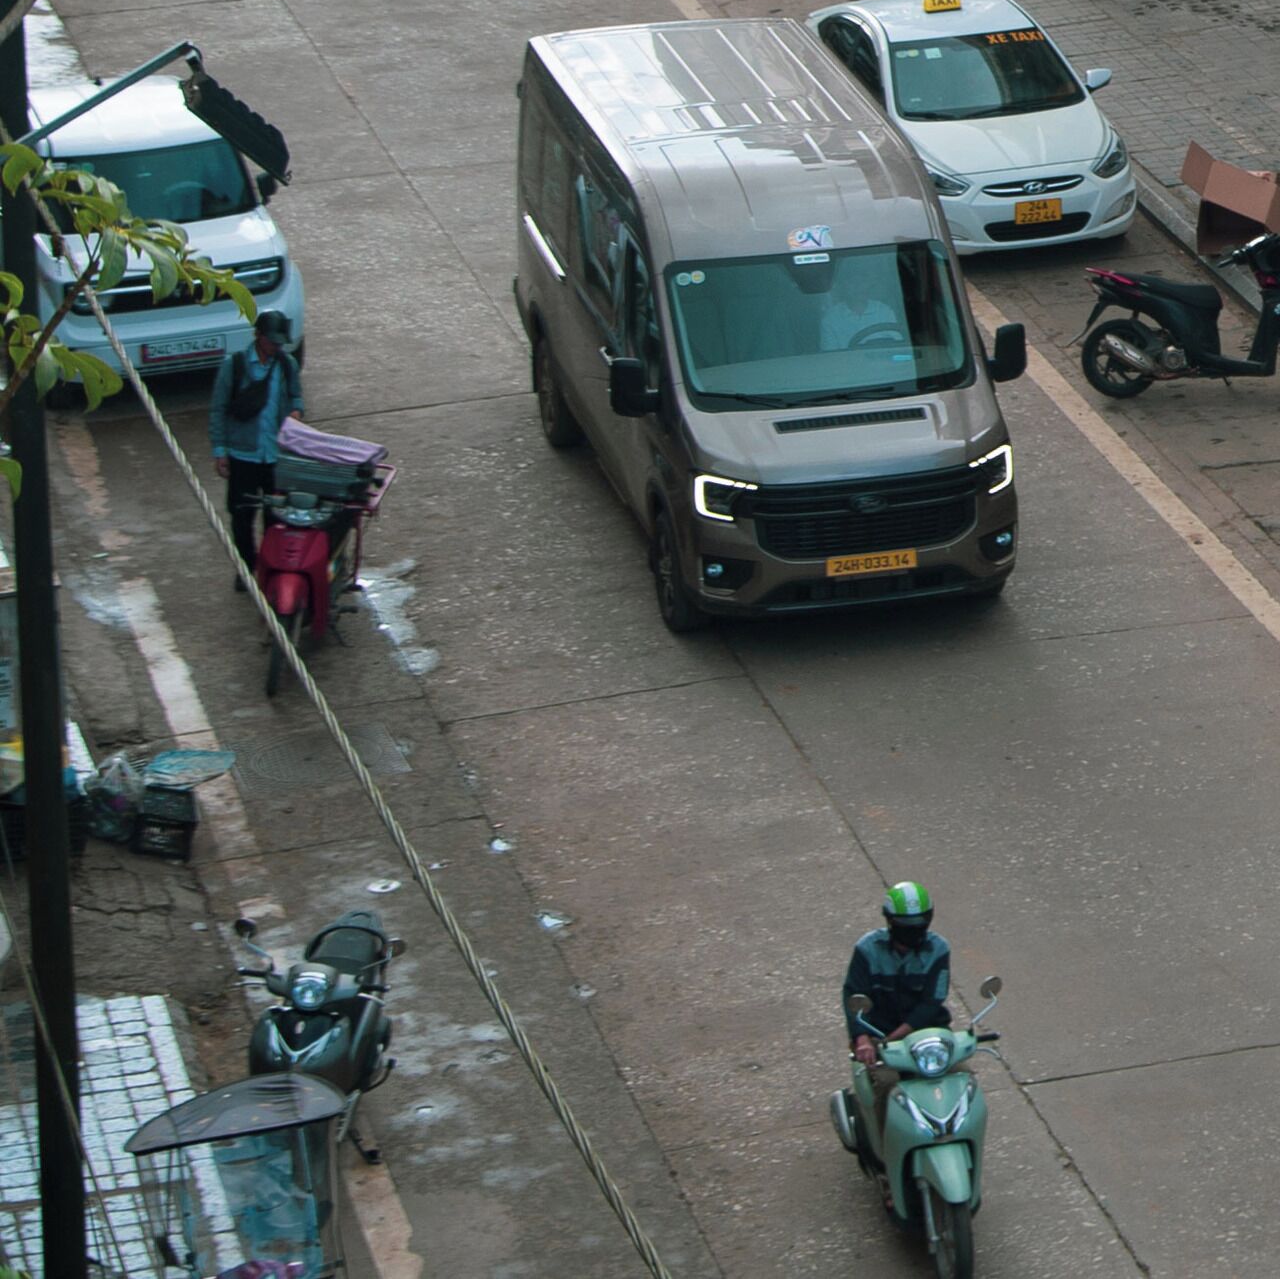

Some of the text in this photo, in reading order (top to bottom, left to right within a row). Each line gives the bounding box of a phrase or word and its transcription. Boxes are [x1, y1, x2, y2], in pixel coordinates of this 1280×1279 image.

[986, 30, 1044, 44] XE TAXI
[833, 554, 909, 573] 24H-033.14
